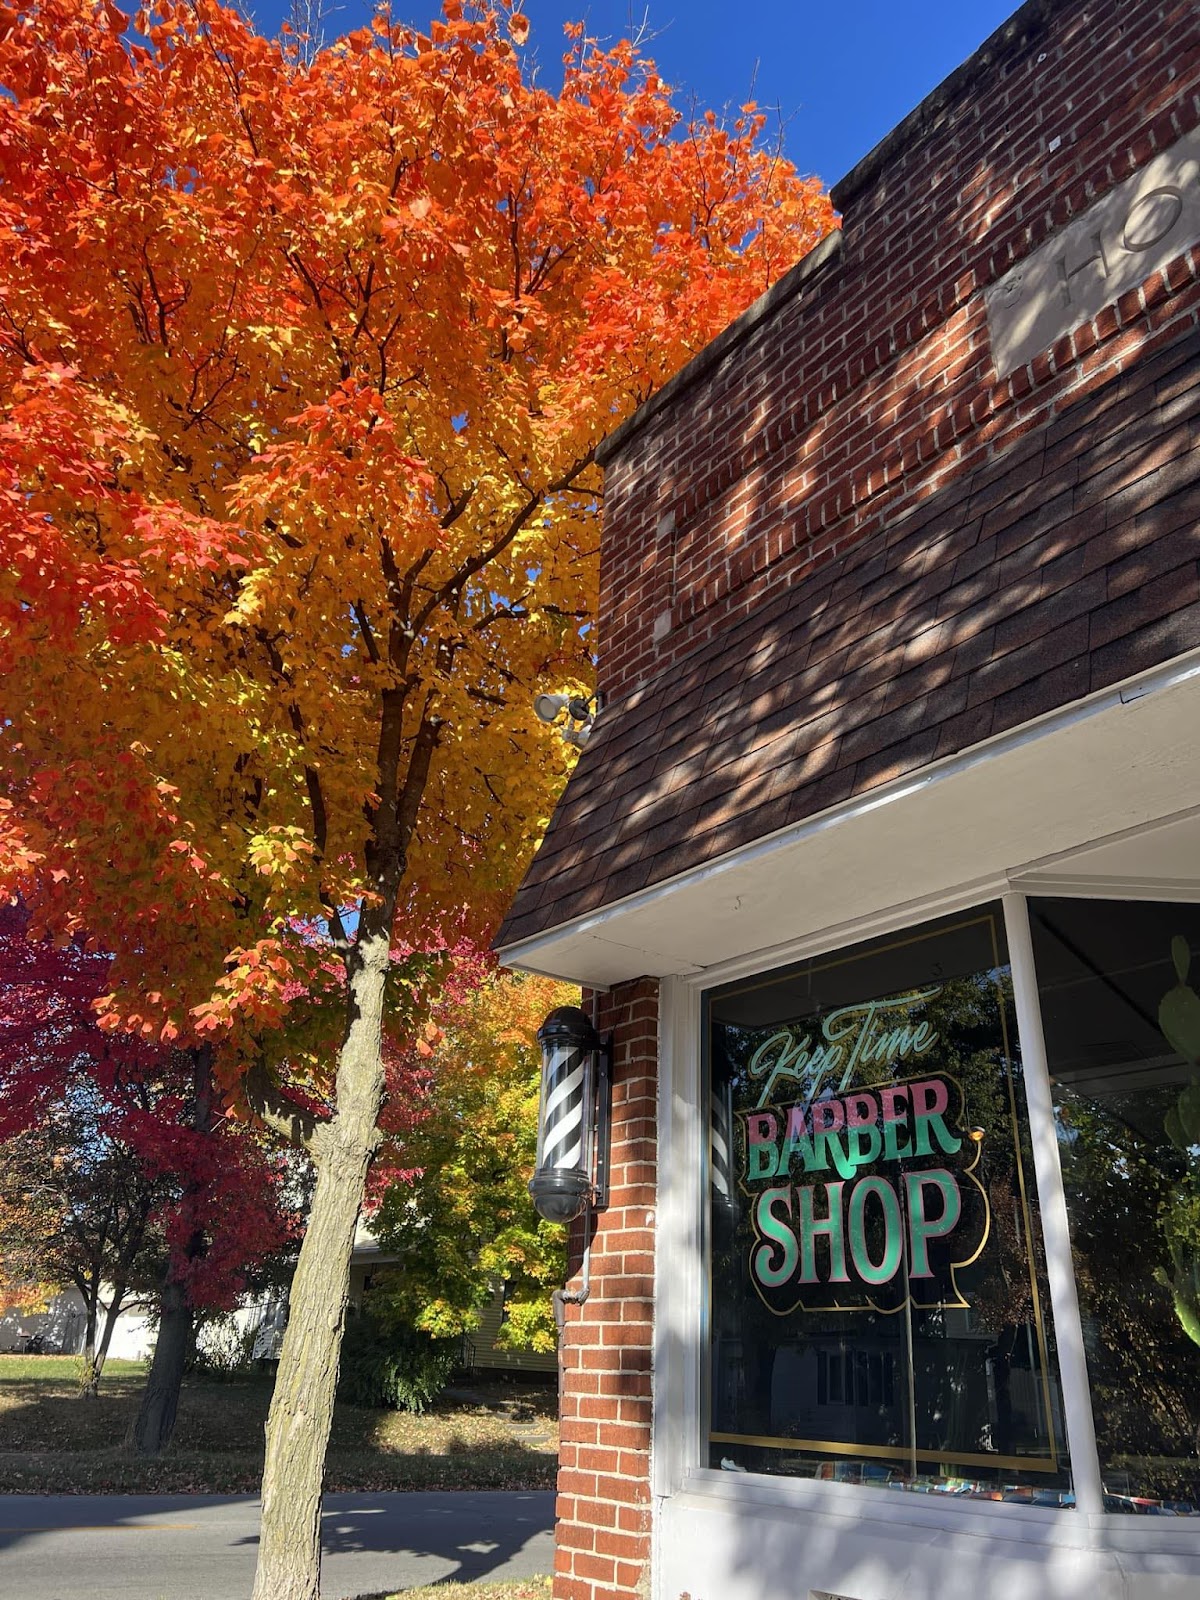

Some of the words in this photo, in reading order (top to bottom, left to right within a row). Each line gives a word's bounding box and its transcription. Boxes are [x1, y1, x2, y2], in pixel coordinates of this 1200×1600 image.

[750, 1031, 842, 1108] Keep
[822, 987, 942, 1091] Time
[746, 1079, 962, 1181] BARBER
[754, 1167, 962, 1288] SHOP
